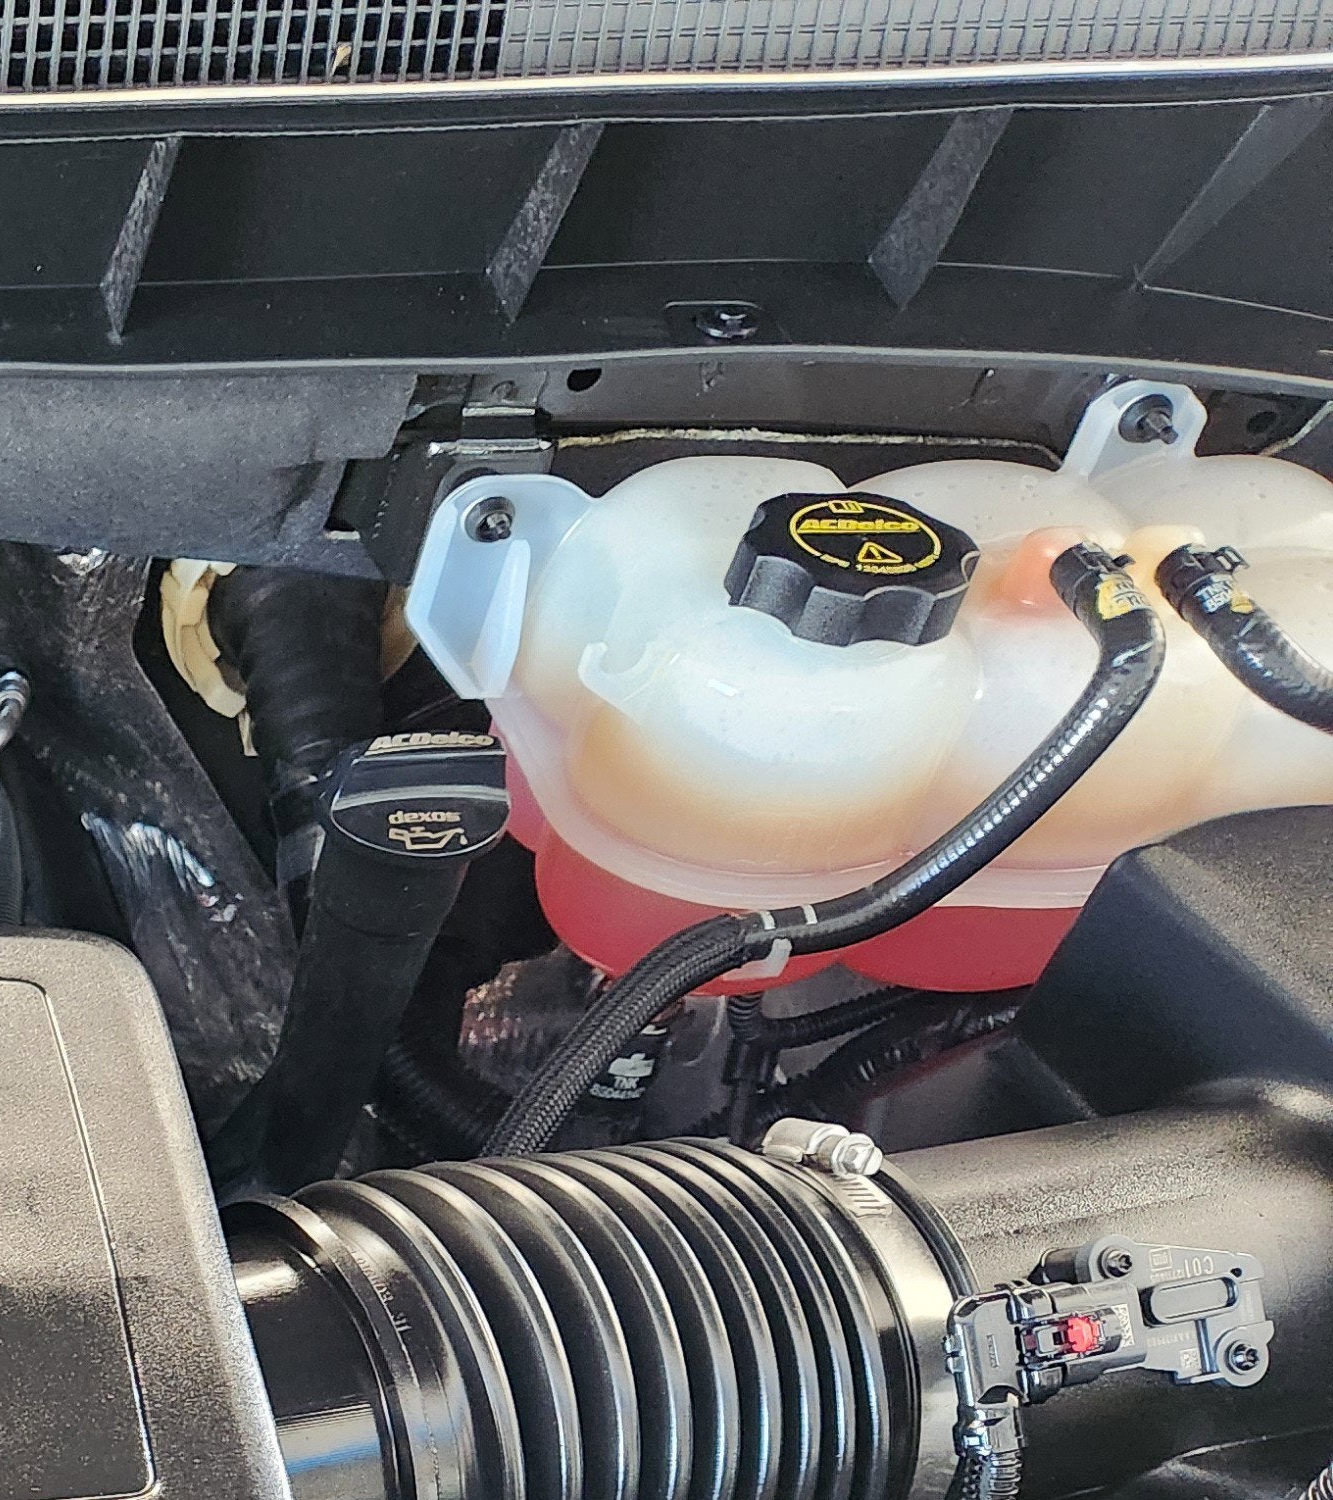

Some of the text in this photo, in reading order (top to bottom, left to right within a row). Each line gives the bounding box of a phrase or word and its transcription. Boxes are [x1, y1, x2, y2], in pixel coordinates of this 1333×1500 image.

[799, 518, 921, 532] ACDelco
[368, 731, 495, 751] ACDelco
[388, 809, 462, 825] dexos
